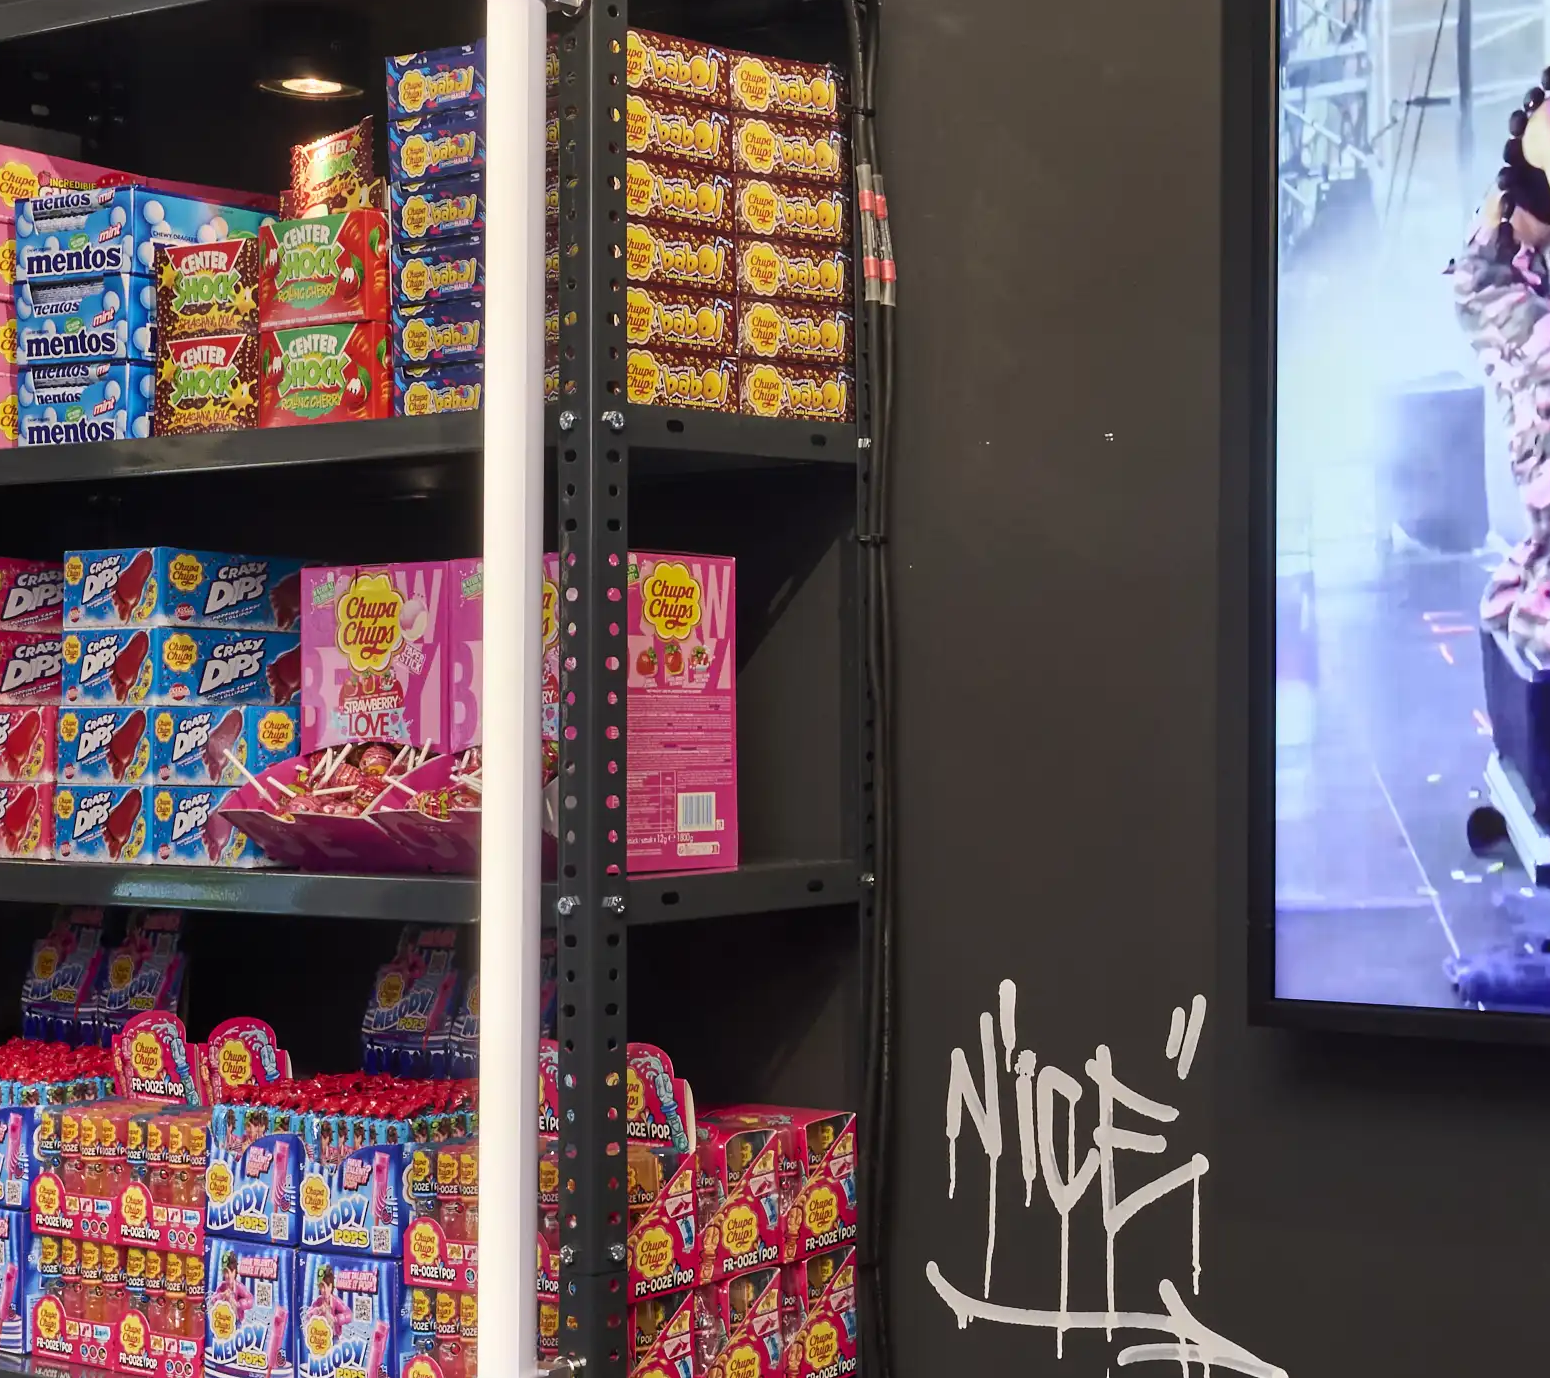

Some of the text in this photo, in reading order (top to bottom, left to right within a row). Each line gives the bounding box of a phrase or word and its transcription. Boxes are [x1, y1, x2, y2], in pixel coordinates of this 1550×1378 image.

[741, 70, 767, 84] Chupa
[740, 82, 767, 101] Chups
[1, 170, 36, 187] Chupa
[99, 223, 122, 243] mint
[282, 224, 331, 247] CENTER
[26, 244, 122, 274] mentos
[180, 250, 228, 271] CENTER
[278, 245, 345, 289] SHOCK
[173, 270, 241, 311] SHOCK
[307, 284, 337, 300] CHERRY
[26, 328, 117, 358] mentos
[93, 398, 116, 416] mint
[28, 420, 116, 444] mentos
[88, 554, 121, 573] CRAZY
[170, 561, 200, 574] Chupa
[217, 561, 267, 580] CRAZY
[82, 568, 121, 605] DIPS
[169, 571, 200, 590] Chups
[651, 579, 695, 601] Chupa
[202, 577, 265, 617] DIPS
[346, 596, 397, 621] Chupa
[649, 598, 693, 629] Chups
[213, 638, 264, 658] CRAZY
[343, 618, 396, 660] Chups
[199, 651, 264, 696] DIPS
[344, 692, 402, 714] STRAWBERRY
[352, 712, 390, 736] LOVE
[135, 1041, 159, 1056] Chupa
[134, 1053, 158, 1071] Chups
[208, 1184, 268, 1227] MELODY
[236, 1216, 268, 1232] POPS
[308, 1340, 367, 1376] MELODY
